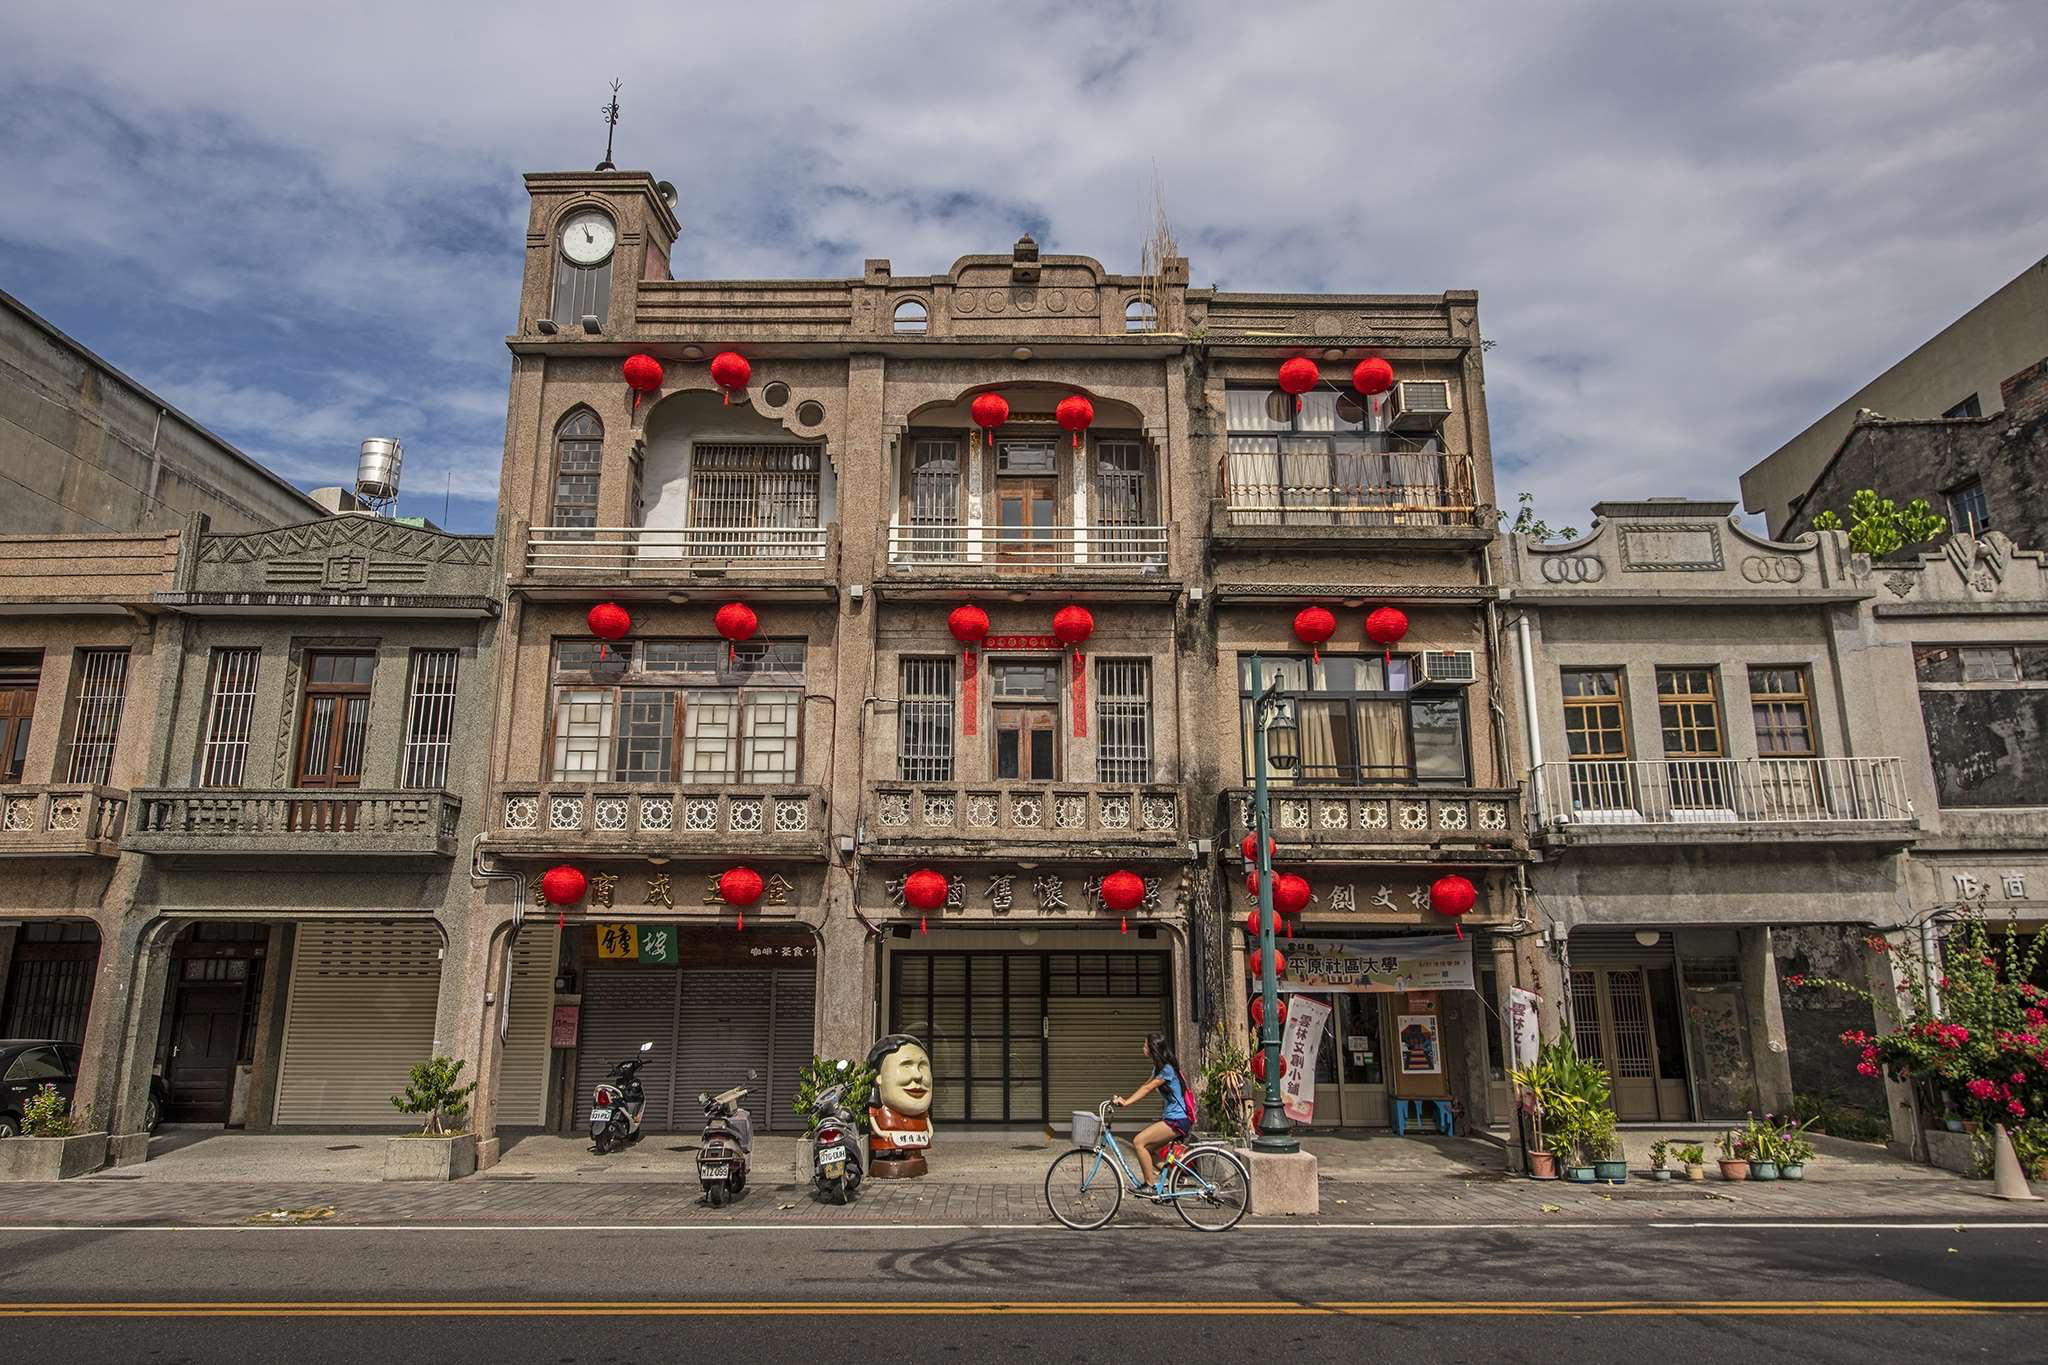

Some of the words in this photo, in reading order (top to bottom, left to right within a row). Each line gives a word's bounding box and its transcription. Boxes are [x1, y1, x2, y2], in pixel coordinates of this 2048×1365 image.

[1288, 956, 1398, 976] 平原社區大學
